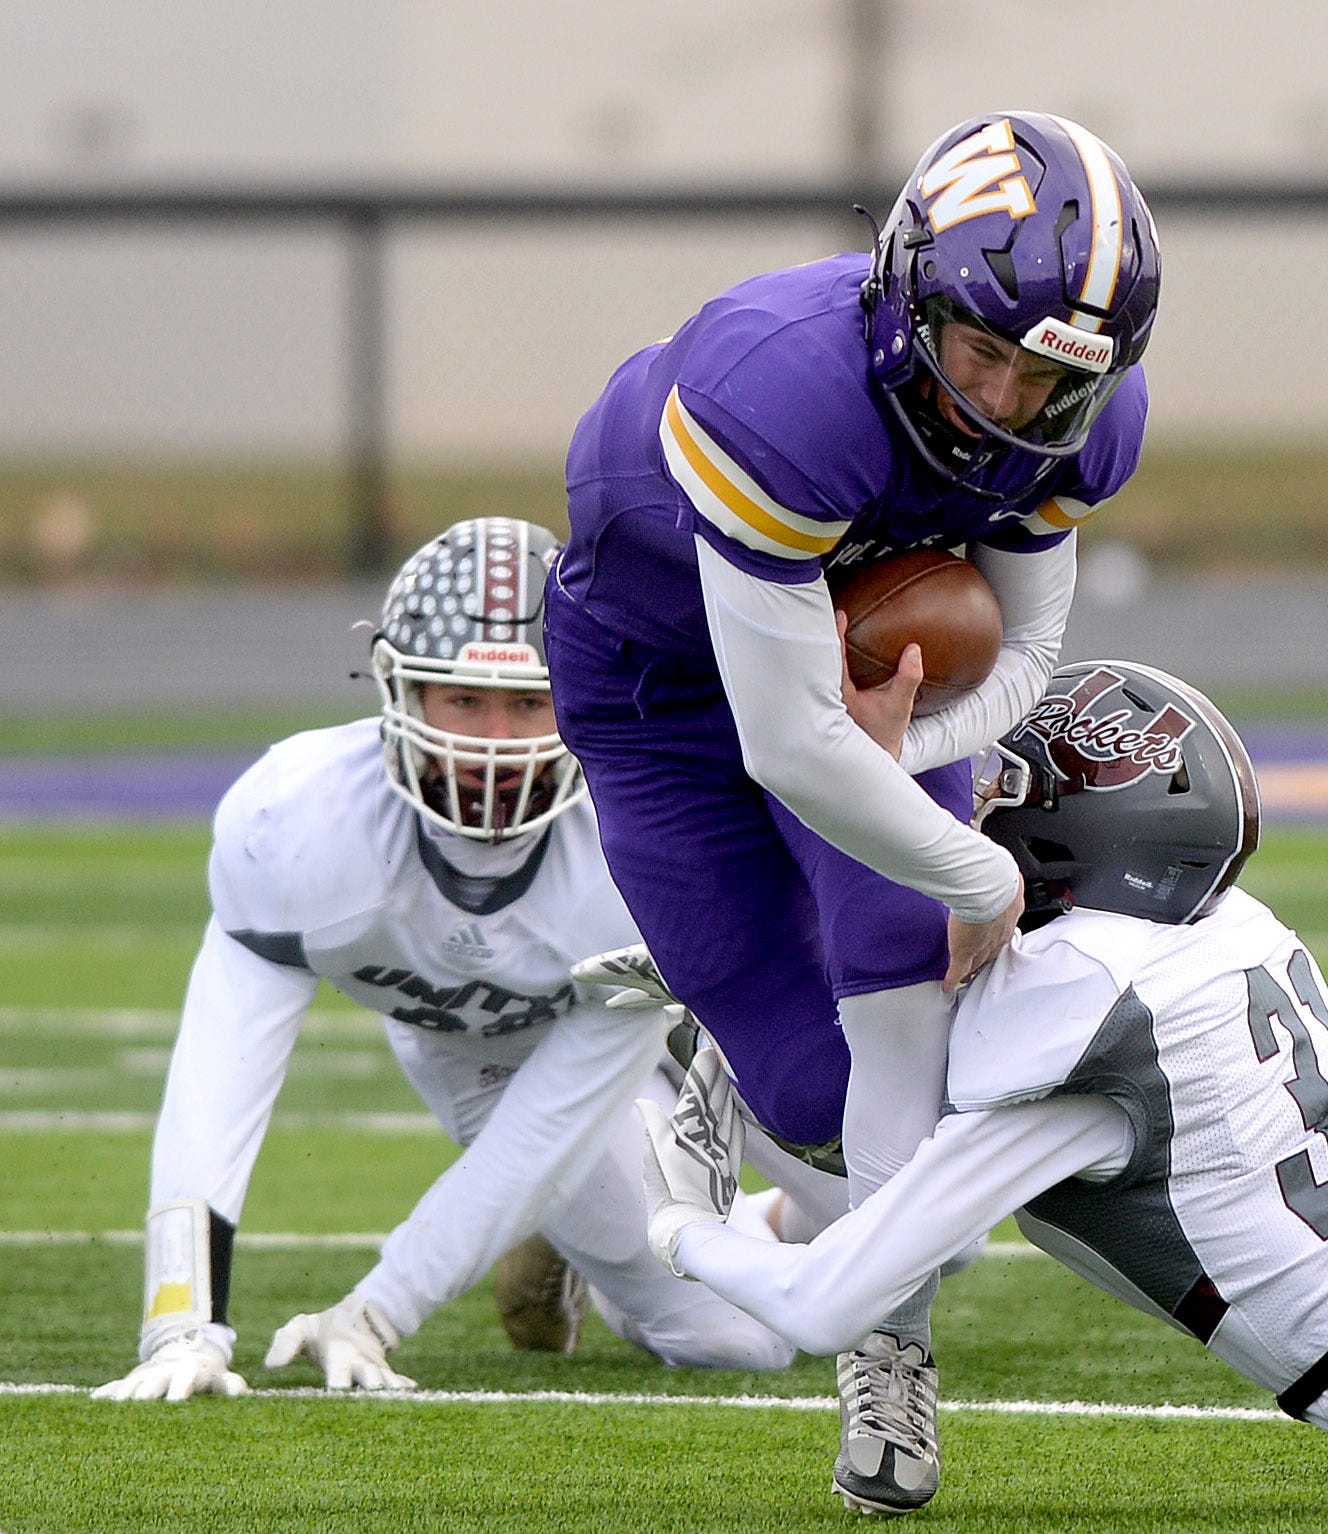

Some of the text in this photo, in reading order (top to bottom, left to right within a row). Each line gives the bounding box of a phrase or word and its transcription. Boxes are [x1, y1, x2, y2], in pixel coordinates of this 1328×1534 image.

[920, 118, 1037, 234] W
[1040, 329, 1109, 364] Riddell
[467, 649, 529, 662] Riddell
[1012, 694, 1184, 775] Rockets
